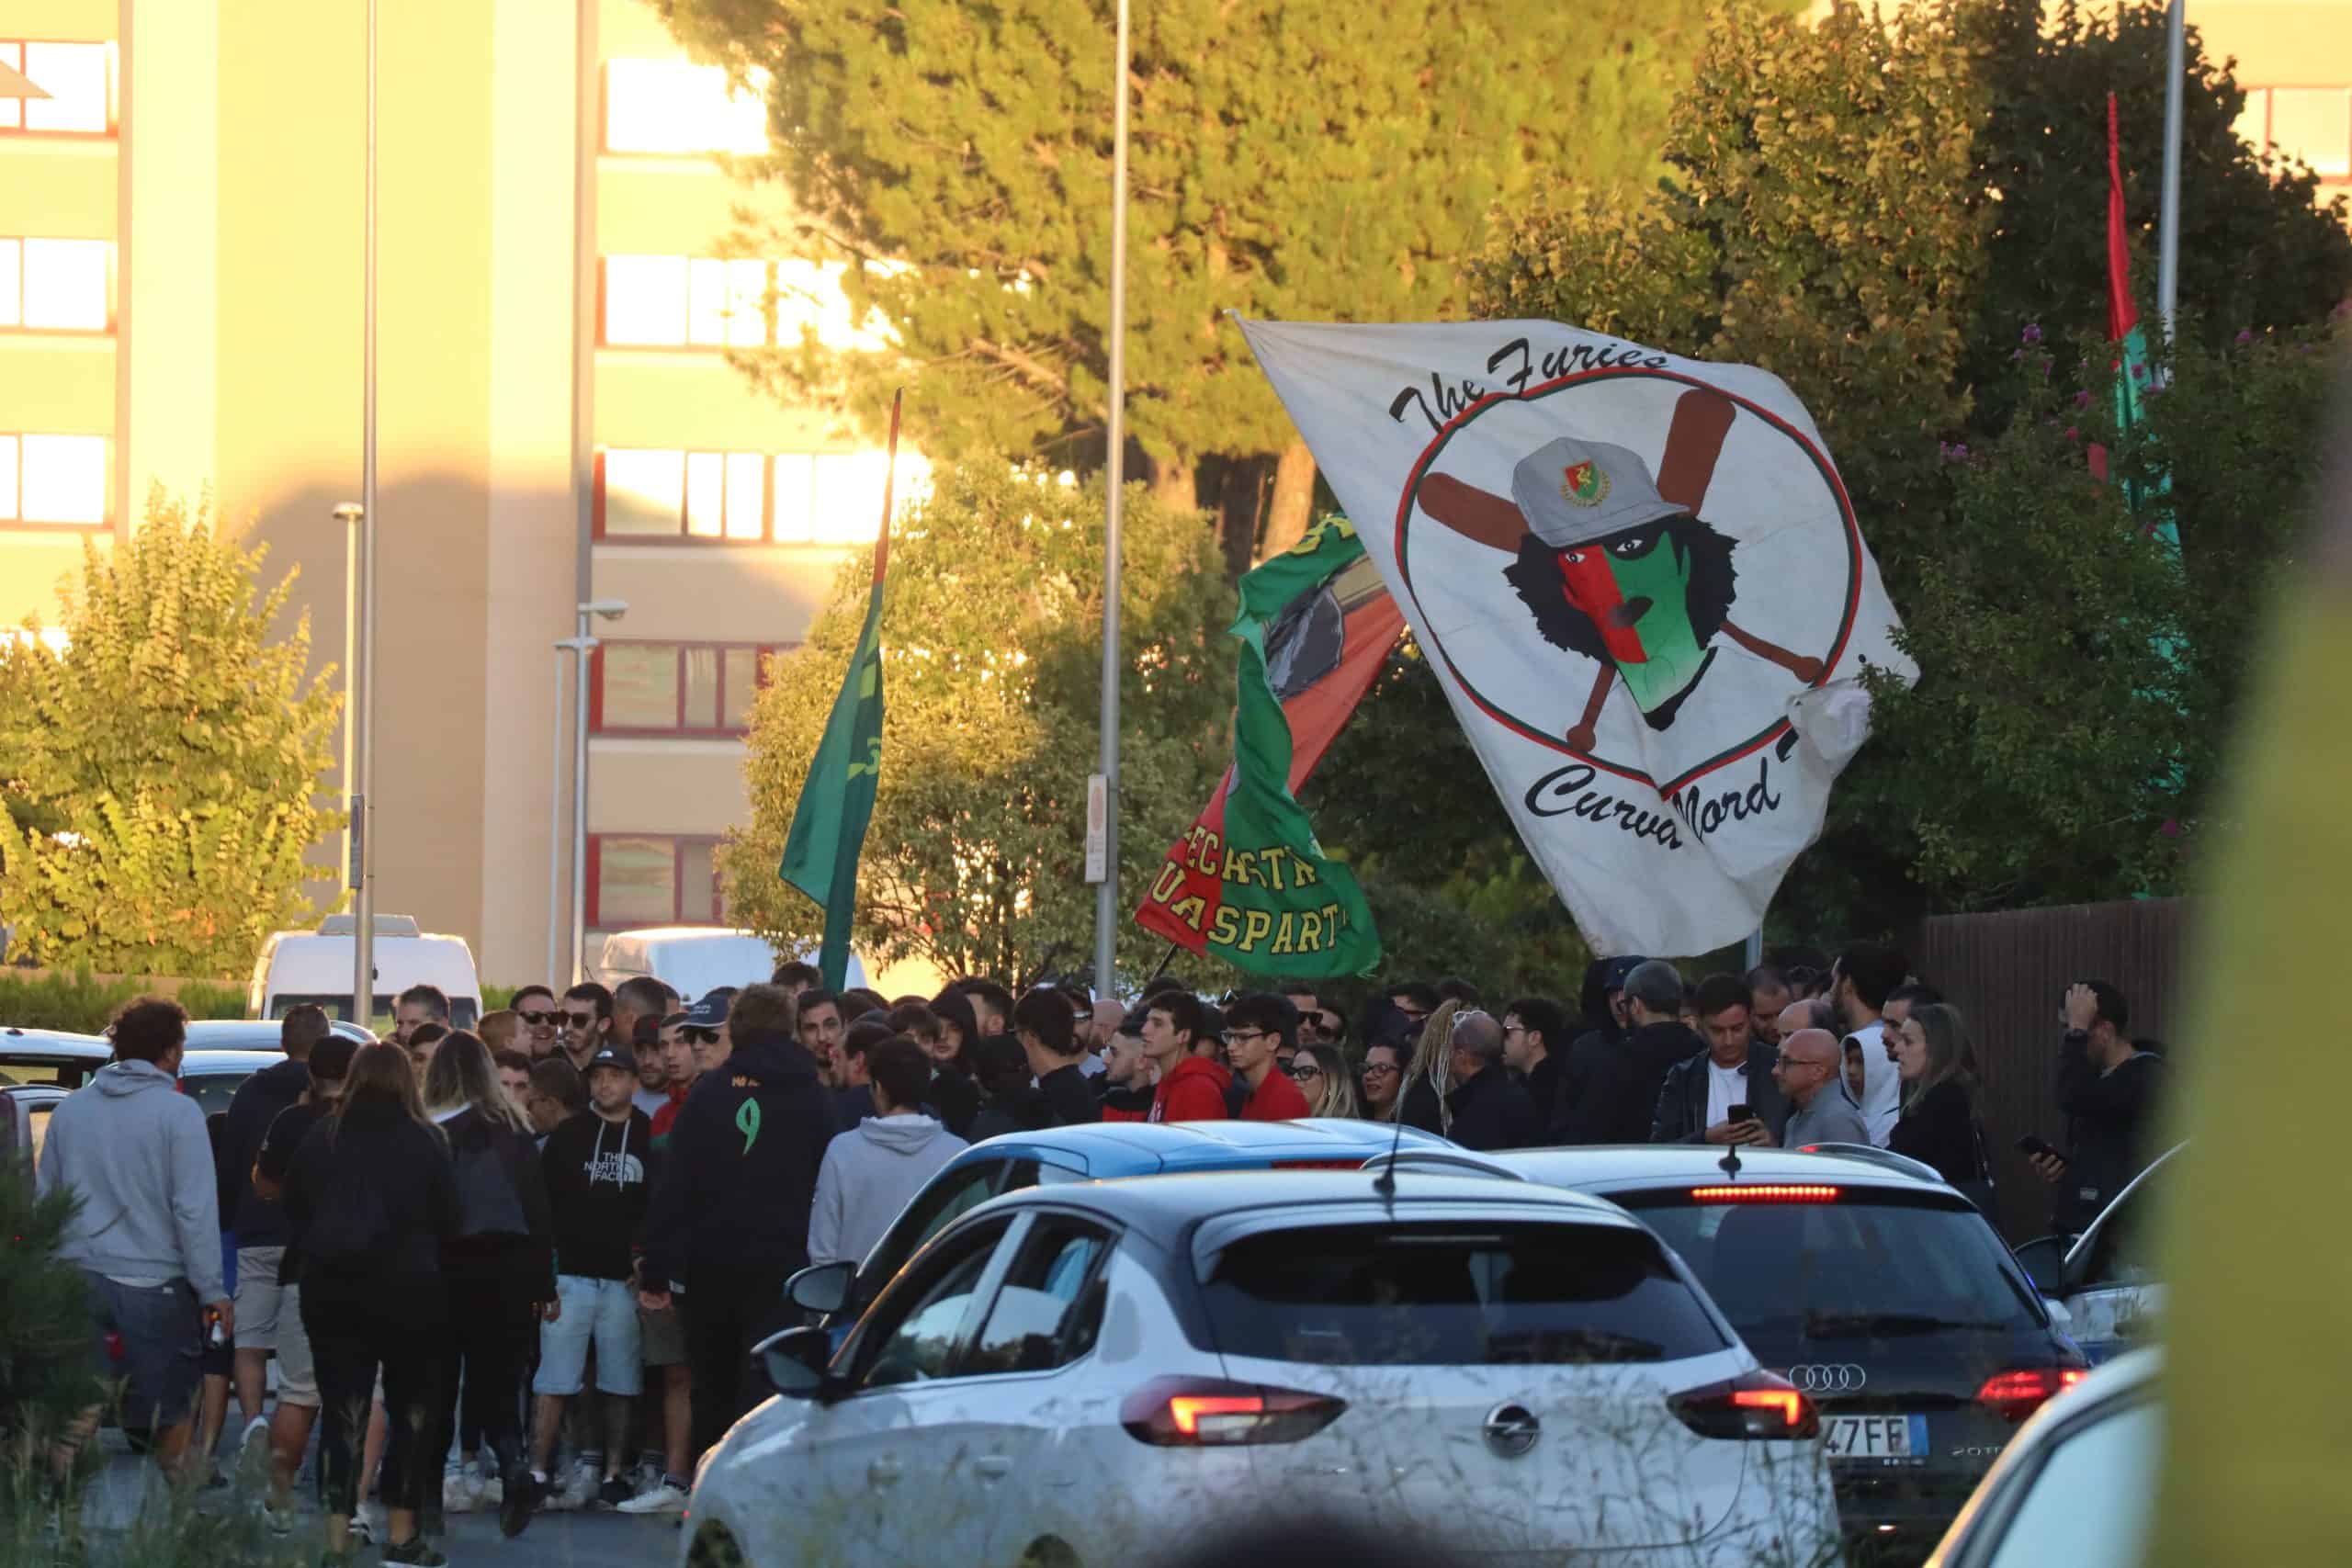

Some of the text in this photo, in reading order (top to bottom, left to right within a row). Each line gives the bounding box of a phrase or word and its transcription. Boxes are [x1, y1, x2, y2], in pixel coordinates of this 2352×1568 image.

[1388, 337, 1669, 434] The Furies
[1524, 763, 1683, 850] Curva
